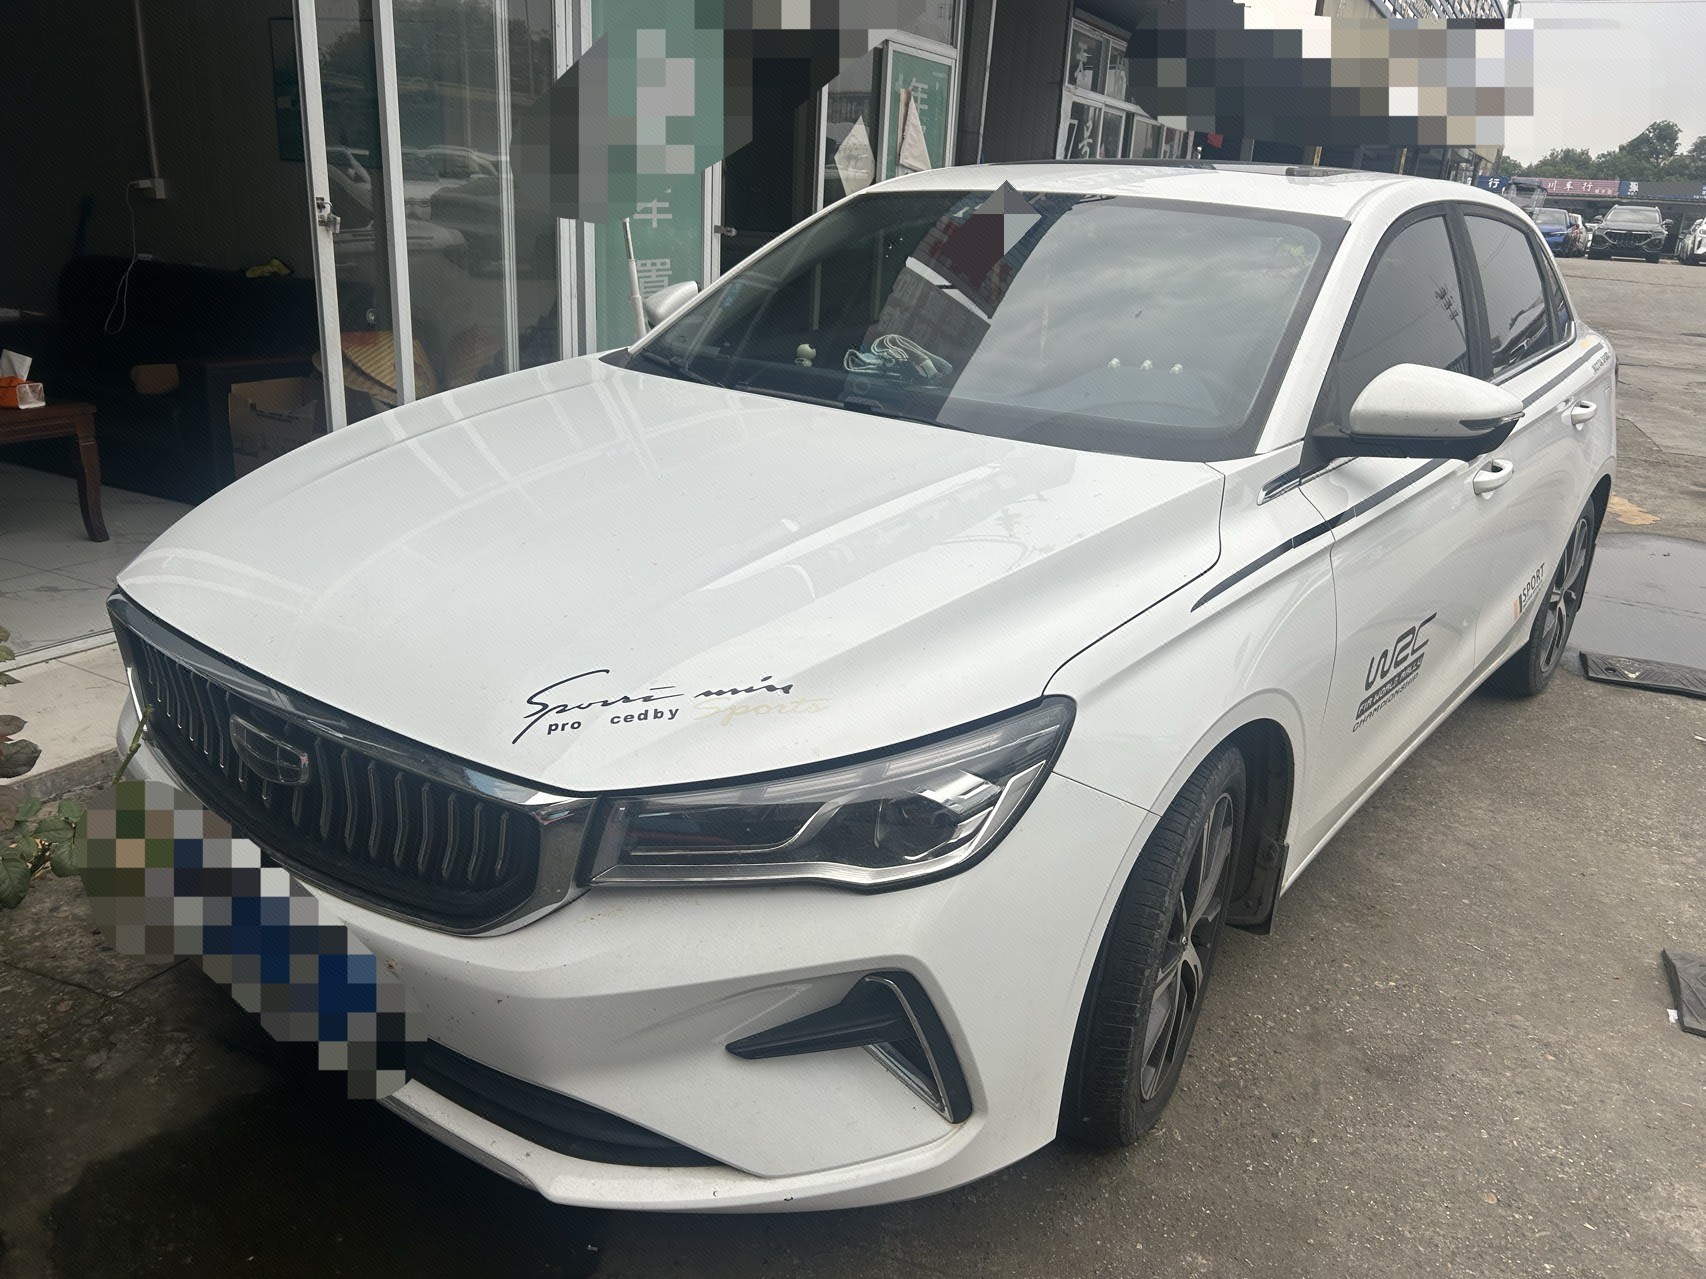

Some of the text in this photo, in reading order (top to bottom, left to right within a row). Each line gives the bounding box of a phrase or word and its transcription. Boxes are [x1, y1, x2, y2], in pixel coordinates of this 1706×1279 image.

[1522, 562, 1545, 603] SPORT
[1352, 672, 1419, 733] CHAMPIONSHIP
[546, 720, 583, 736] pro
